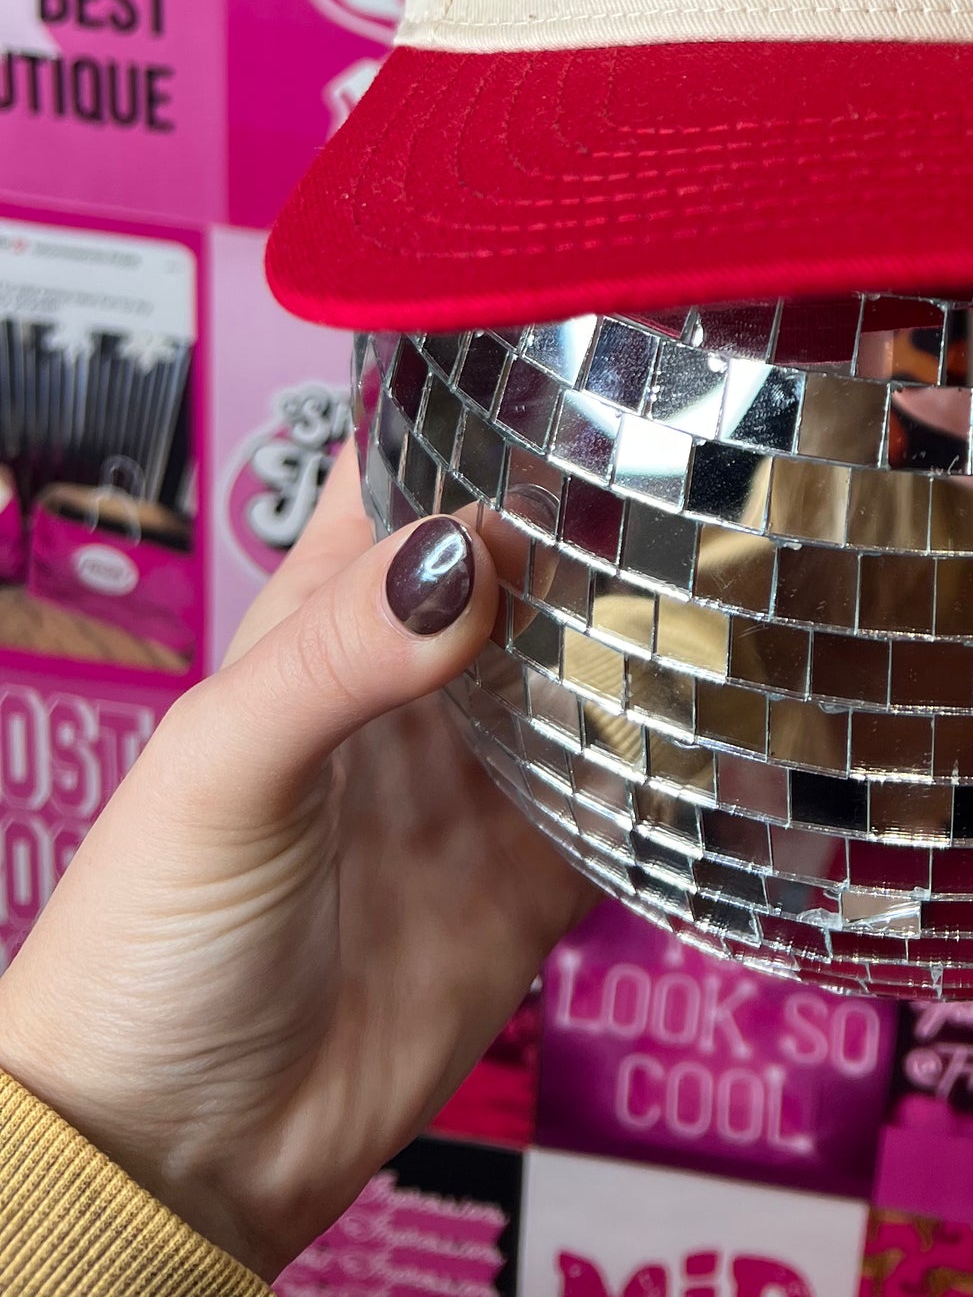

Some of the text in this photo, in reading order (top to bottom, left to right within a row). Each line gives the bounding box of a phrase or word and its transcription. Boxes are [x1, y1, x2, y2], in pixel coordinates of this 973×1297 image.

[554, 948, 881, 1079] LOOK SO
[614, 1052, 815, 1153] COOL
